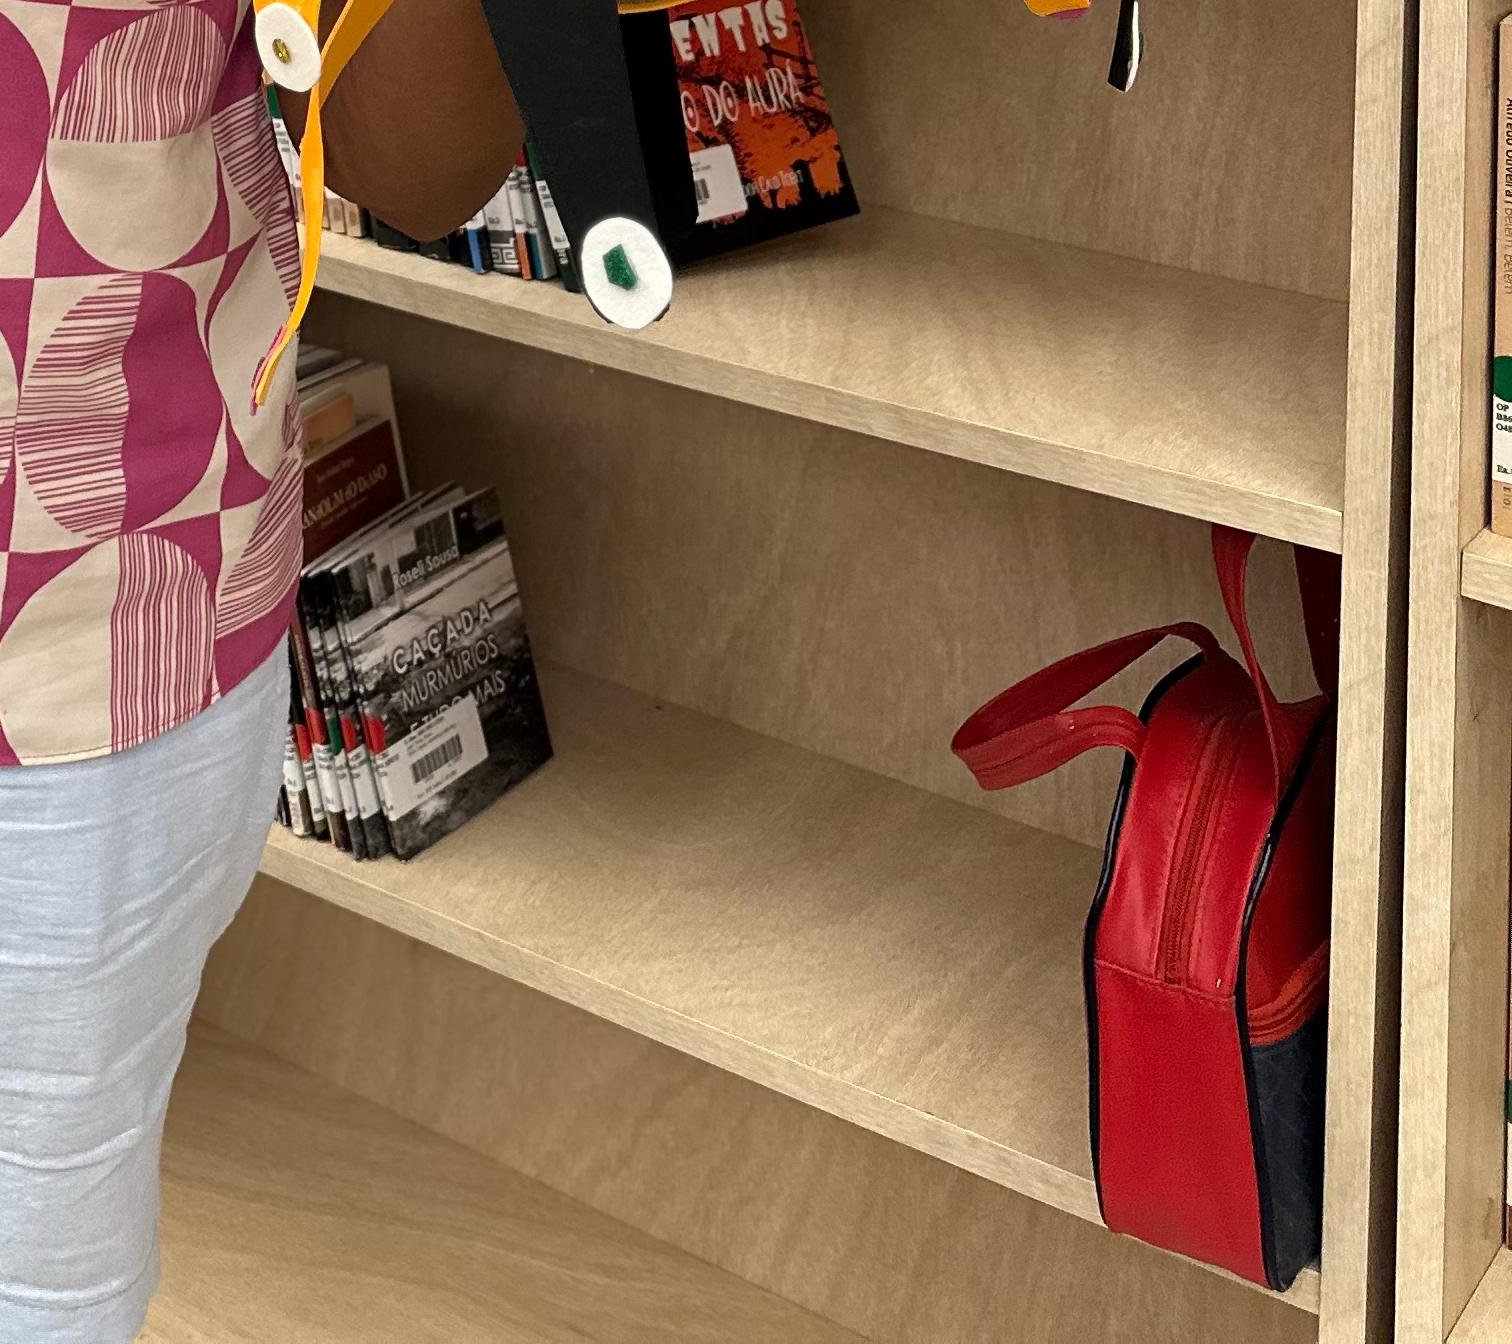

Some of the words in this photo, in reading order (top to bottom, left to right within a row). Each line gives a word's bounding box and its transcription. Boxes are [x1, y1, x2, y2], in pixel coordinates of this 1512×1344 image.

[702, 80, 739, 128] DO
[1496, 403, 1509, 412] OP
[392, 599, 492, 674] CAÇADA
[400, 634, 499, 712] MURMÚRIOS
